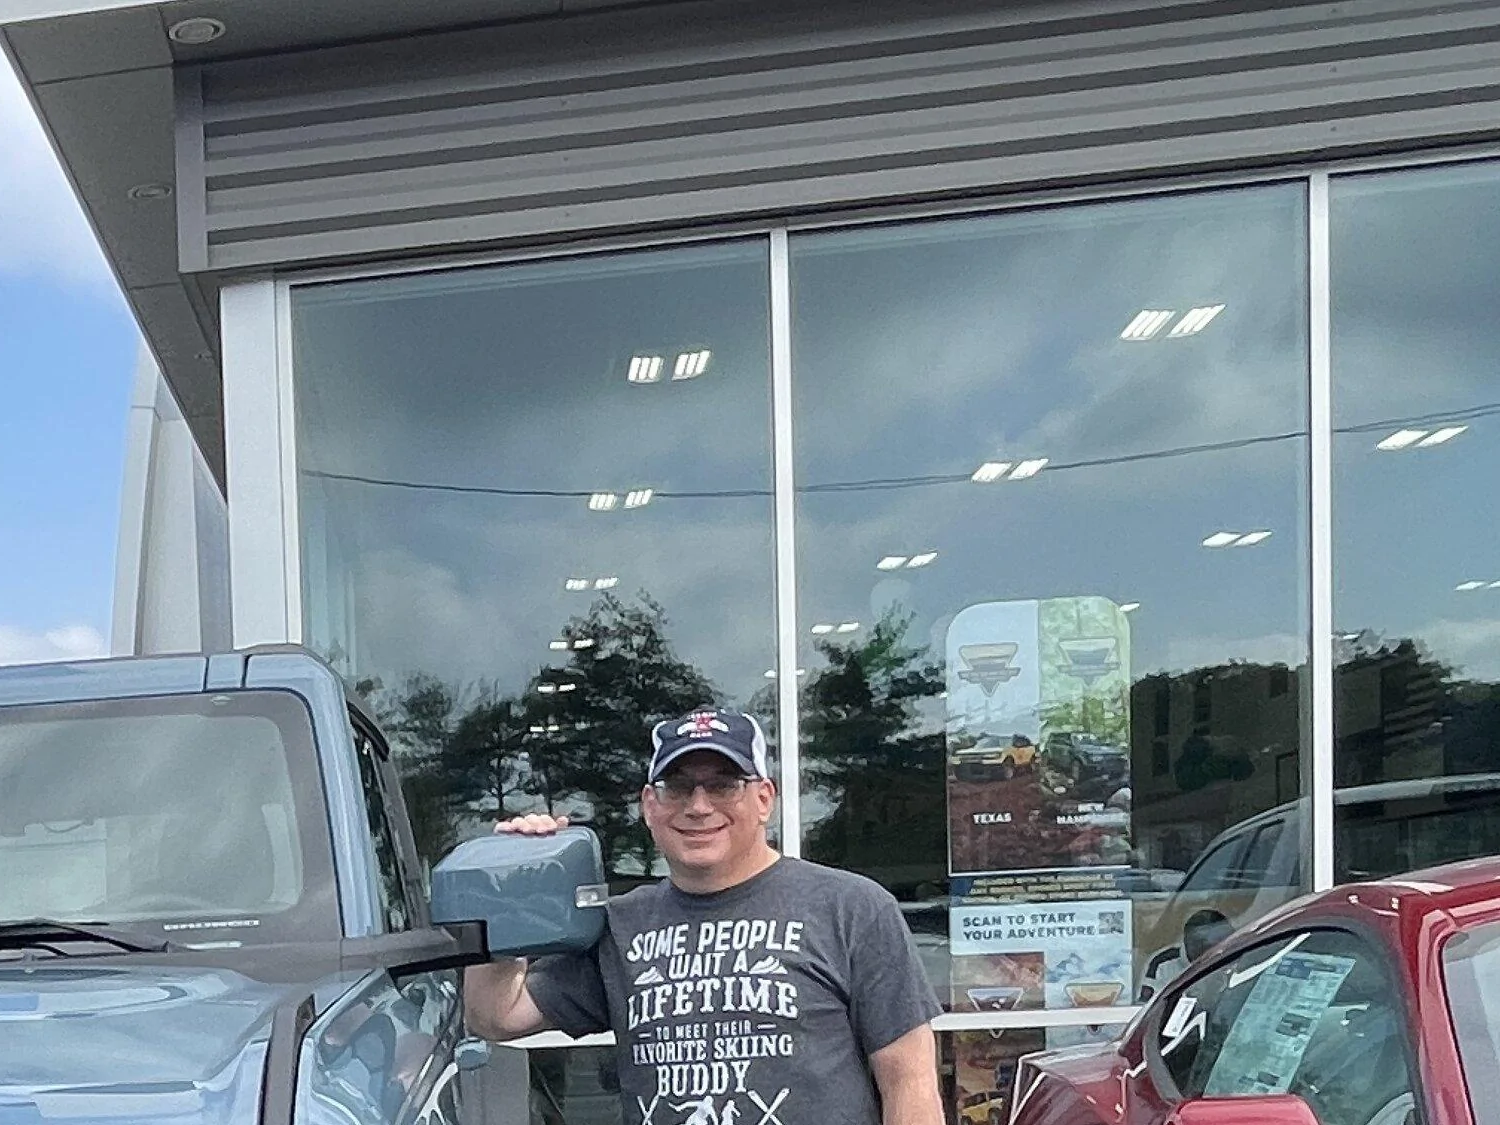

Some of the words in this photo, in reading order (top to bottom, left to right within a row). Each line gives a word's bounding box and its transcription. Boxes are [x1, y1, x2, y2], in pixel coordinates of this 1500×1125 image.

[973, 813, 1011, 824] TEXAS
[963, 915, 1002, 928] SCAN
[1007, 914, 1025, 926] TO
[1030, 912, 1076, 924] START
[963, 929, 1003, 941] YOUR
[1007, 925, 1096, 940] ADVENTURE
[627, 923, 688, 963] SOME
[699, 919, 804, 954] PEOPLE
[668, 952, 725, 979] WAIT
[734, 949, 748, 973] A
[628, 976, 799, 1030] LIFETIME
[656, 1026, 670, 1040] TO
[676, 1023, 708, 1039] MEET
[715, 1020, 753, 1036] THEIR
[633, 1040, 707, 1065] FAVORITE
[714, 1034, 794, 1059] SKIING
[655, 1060, 752, 1098] BUDDY
